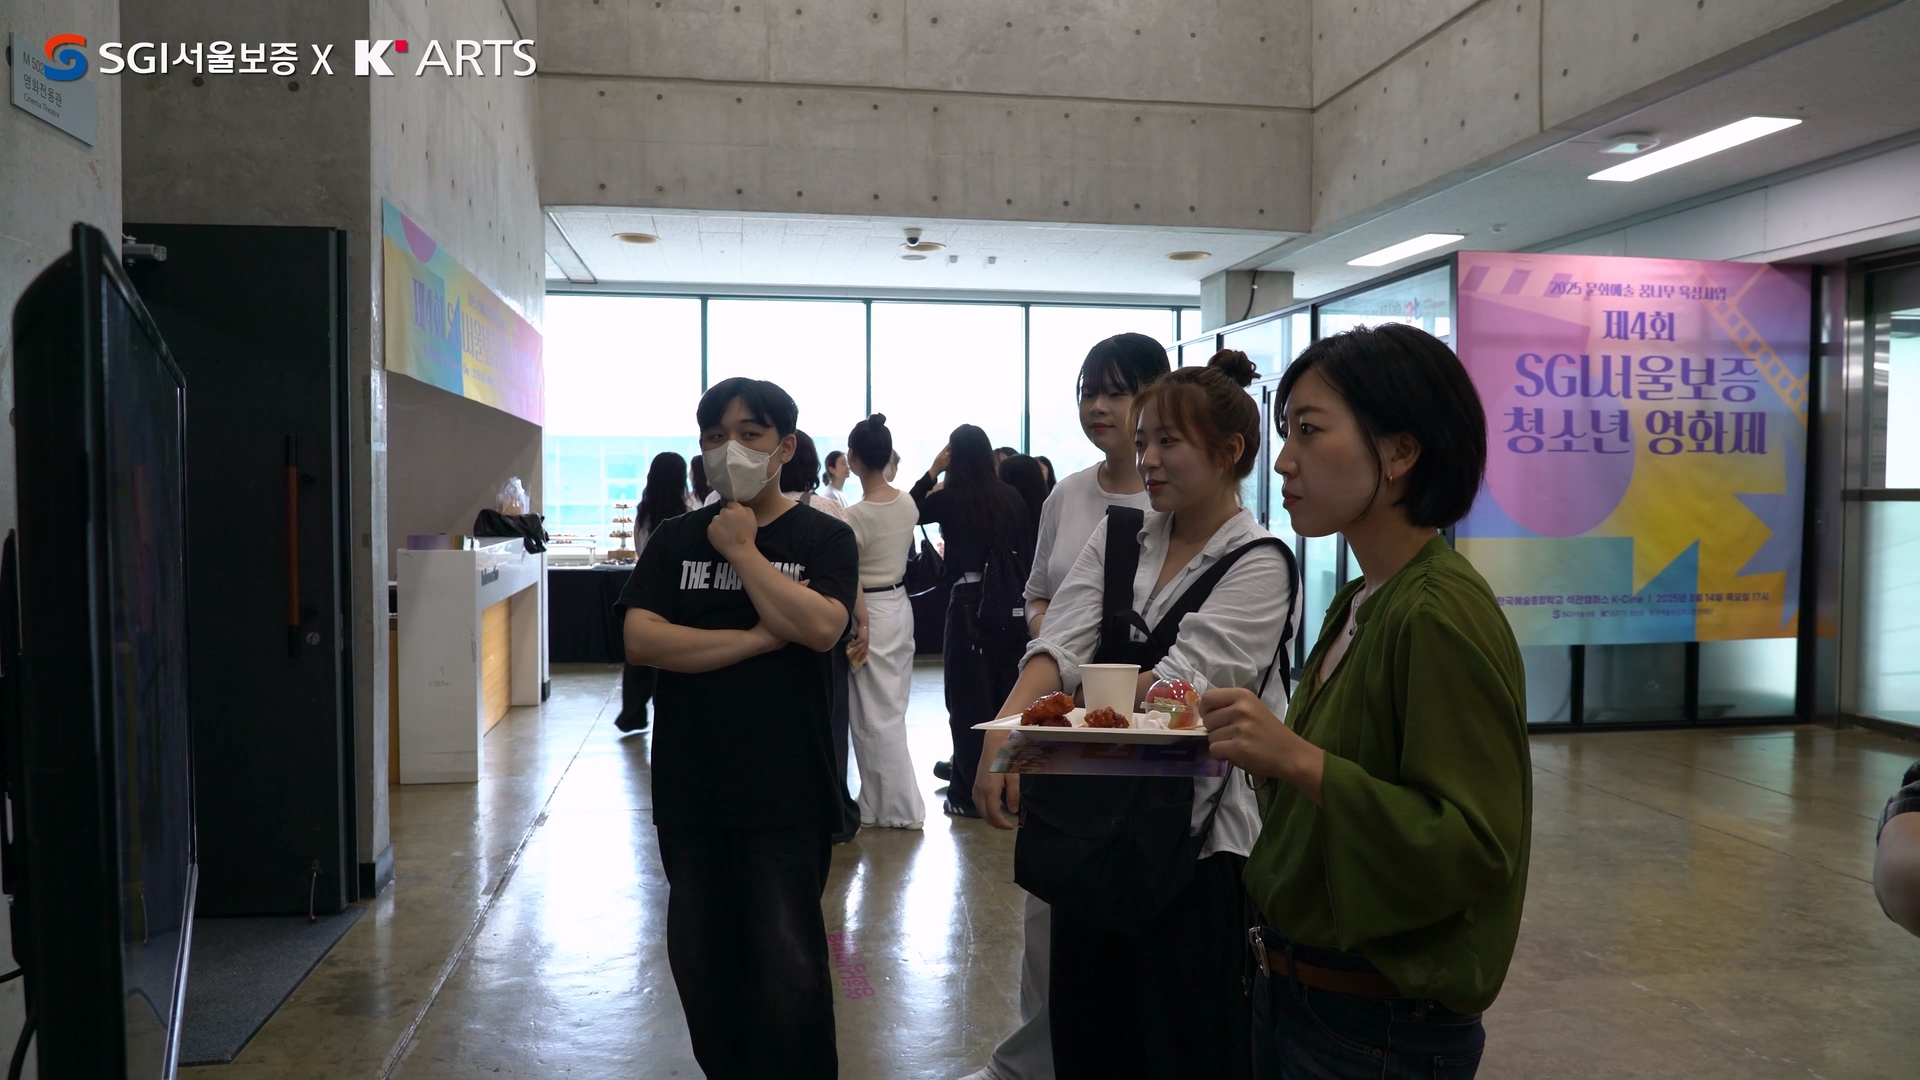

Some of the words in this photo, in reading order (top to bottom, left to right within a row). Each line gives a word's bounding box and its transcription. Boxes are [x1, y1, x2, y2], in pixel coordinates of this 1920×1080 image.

[22, 51, 31, 67] M
[23, 74, 62, 108] 영화전용관
[23, 93, 42, 109] Cinema
[42, 102, 60, 119] Theatre
[1550, 280, 1583, 296] 2025
[1586, 282, 1635, 299] 문화예술
[1639, 284, 1675, 300] 꿈나무
[1679, 285, 1728, 301] 육성사업
[412, 278, 444, 341] 제4회
[1601, 309, 1676, 342] 제4회
[1514, 353, 1760, 403] SGI서울보증
[1502, 406, 1632, 455] 청소년
[1645, 409, 1768, 456] 영화제
[680, 560, 712, 590] THE
[1611, 594, 1644, 605] K-Cine
